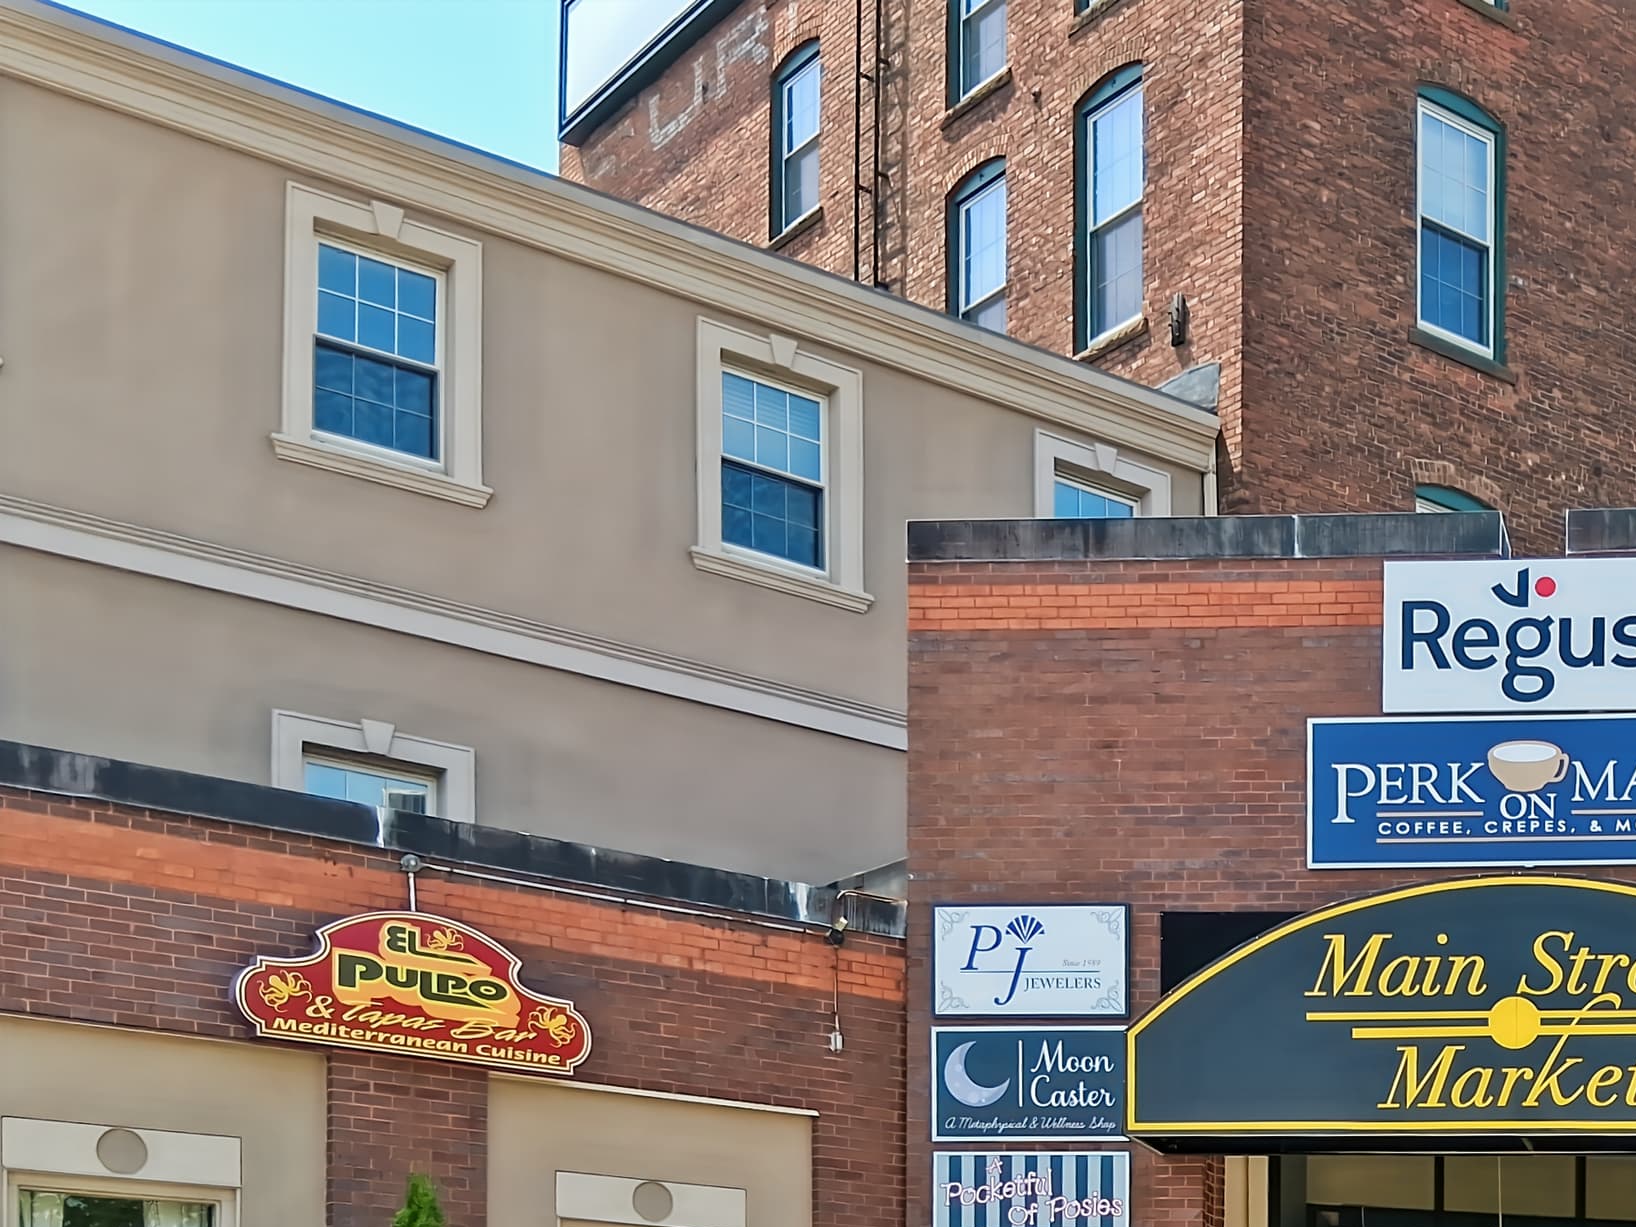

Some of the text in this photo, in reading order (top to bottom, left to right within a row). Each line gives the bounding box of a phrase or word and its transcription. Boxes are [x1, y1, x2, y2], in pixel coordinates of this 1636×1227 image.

[1331, 762, 1486, 824] PERK
[1499, 793, 1557, 820] ON
[1377, 820, 1473, 836] COFFEE,
[1483, 819, 1576, 834] CREPES,
[1589, 819, 1603, 833] &
[337, 953, 510, 1009] PULPO
[1304, 932, 1488, 998] Main
[1023, 977, 1102, 992] JEWELERS
[305, 995, 539, 1044] & Tapas Bar
[271, 1016, 561, 1065] Mediterranean Cuisine
[1030, 1040, 1115, 1074] Moon
[1030, 1075, 1116, 1108] Caster
[945, 1117, 956, 1129] A
[1029, 1117, 1039, 1129] &
[1041, 1117, 1086, 1129] Wellness
[1089, 1116, 1117, 1132] Shop
[986, 1156, 1004, 1175] A
[940, 1168, 1054, 1207] Pocketful
[1008, 1191, 1123, 1226] Of Posies
